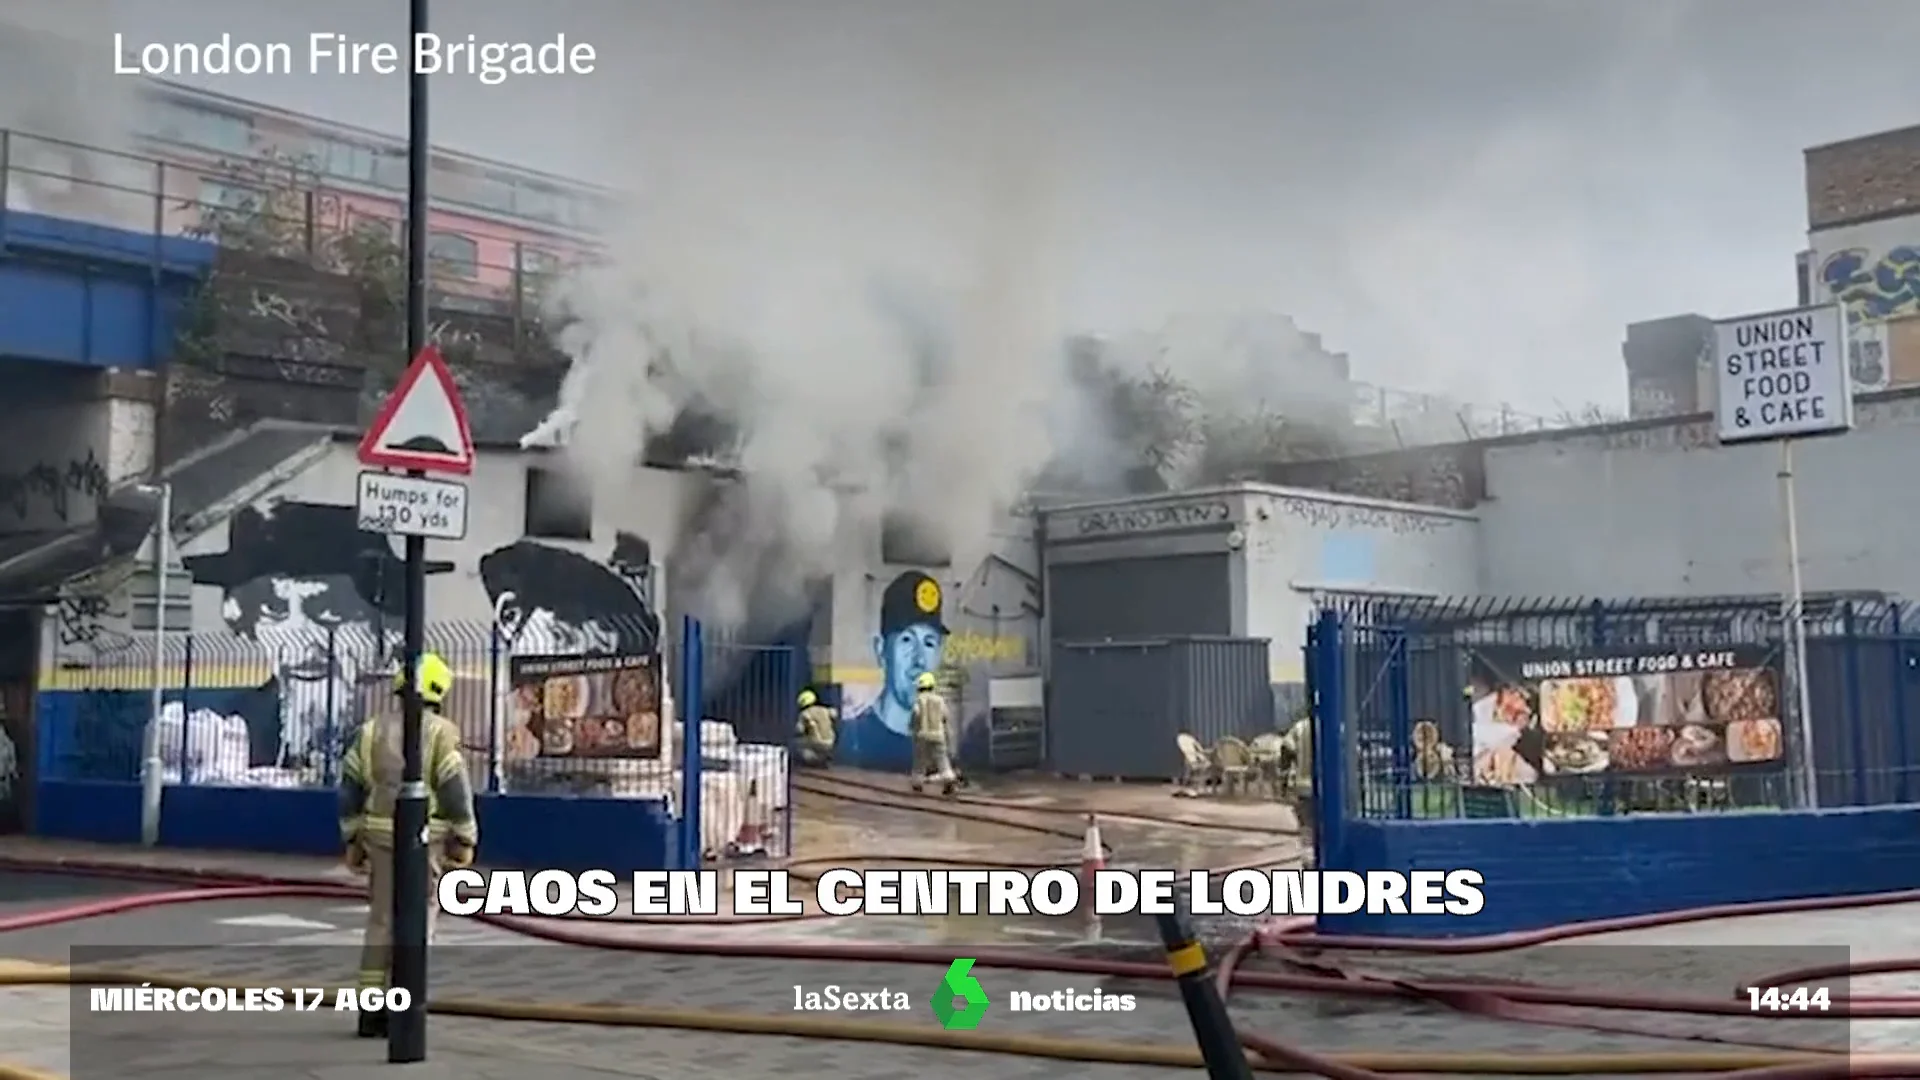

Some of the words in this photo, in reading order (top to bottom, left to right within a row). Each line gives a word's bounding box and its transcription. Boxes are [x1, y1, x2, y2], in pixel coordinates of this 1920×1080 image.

[1736, 316, 1814, 348] UNION
[1727, 341, 1826, 376] STREET
[1744, 371, 1811, 400] FOOD
[1734, 406, 1752, 429] &
[1760, 396, 1826, 425] CAFE
[366, 481, 429, 505] Humps
[436, 489, 460, 508] for
[418, 511, 449, 528] yds
[1522, 661, 1572, 678] UNION
[1574, 657, 1634, 676] STREET
[1637, 655, 1678, 672] FOOD
[1680, 653, 1693, 669] &
[1696, 652, 1735, 668] CAFE
